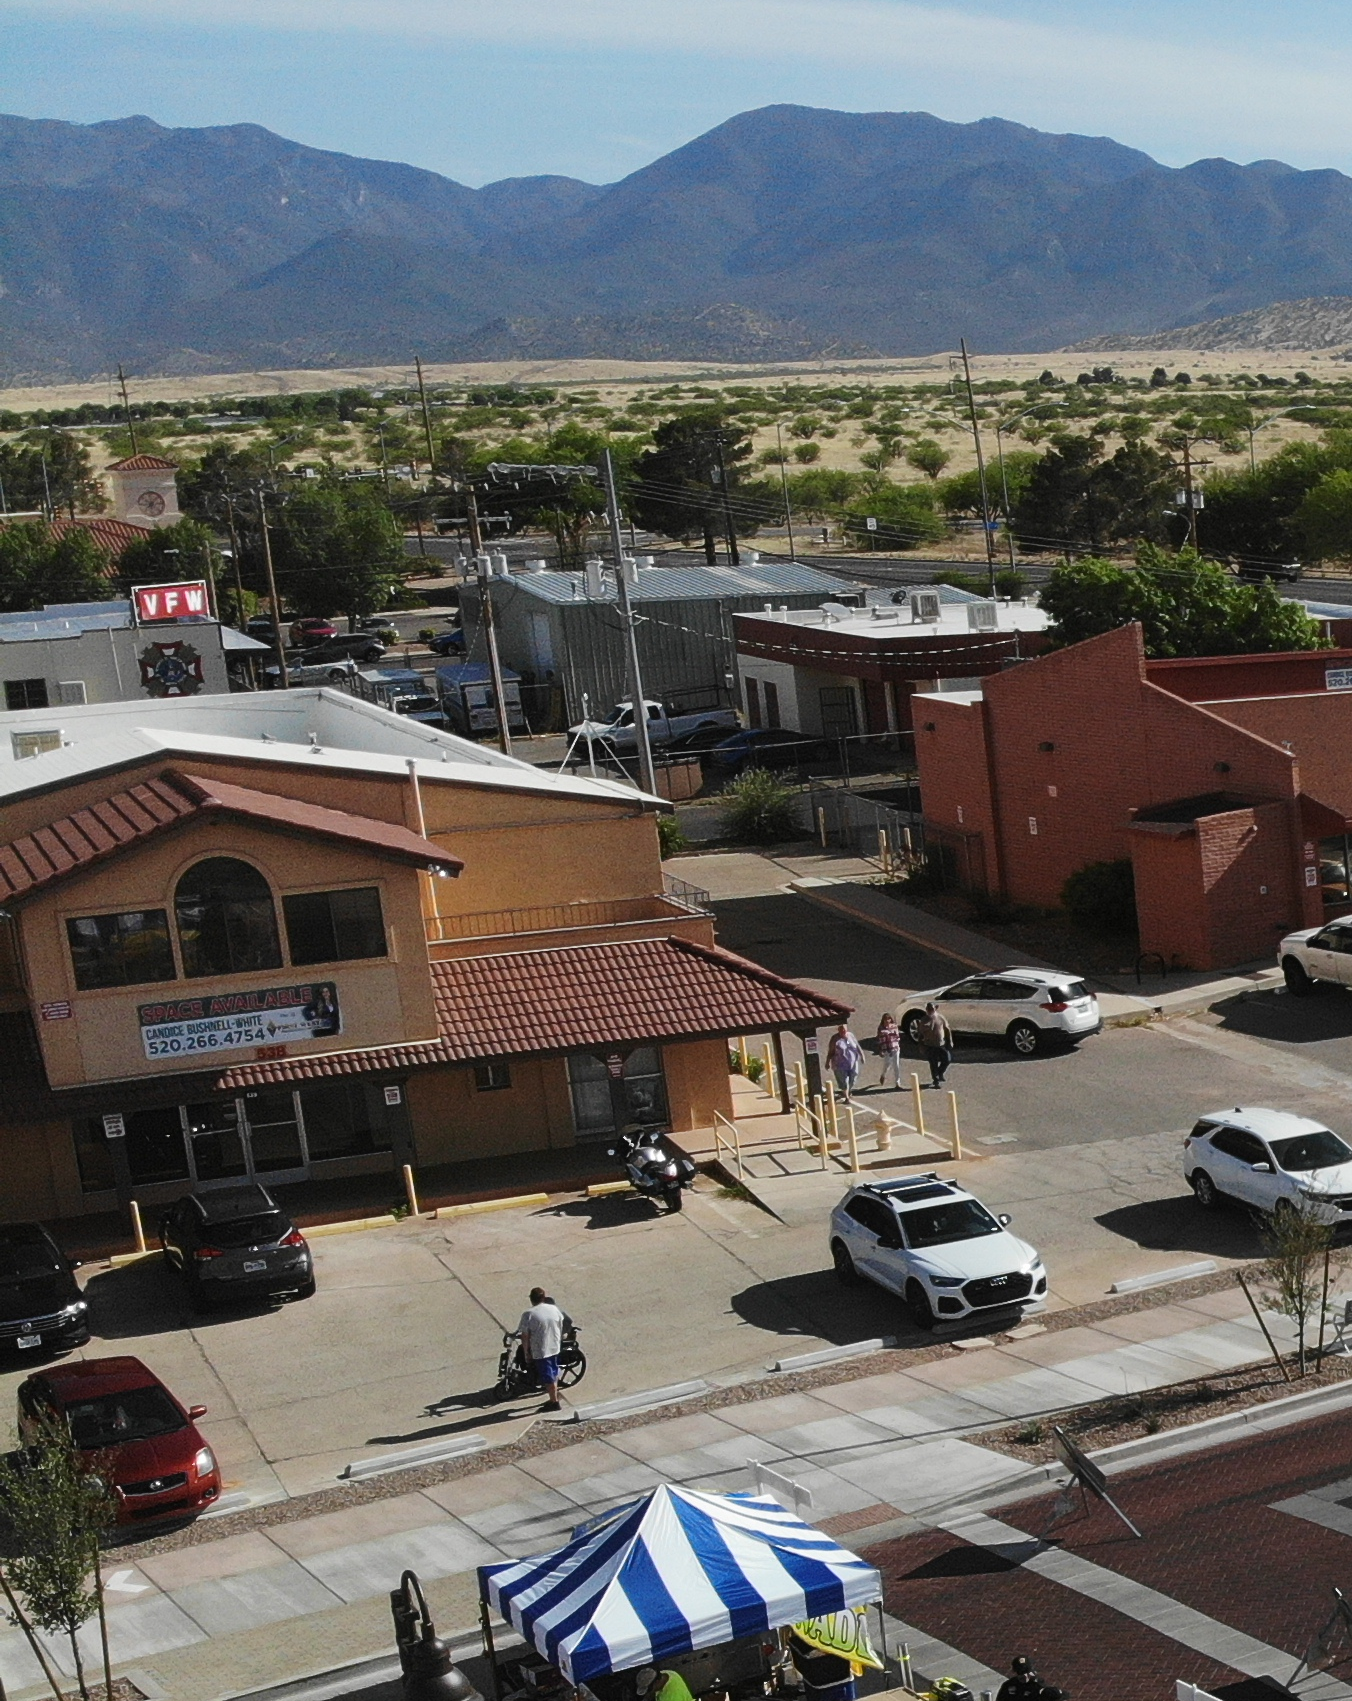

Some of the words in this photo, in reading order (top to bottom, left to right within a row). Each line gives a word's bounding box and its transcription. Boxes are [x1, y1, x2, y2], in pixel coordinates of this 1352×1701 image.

[143, 590, 201, 615] VFW
[142, 1000, 203, 1024] SPACE
[210, 987, 313, 1014] AVAILABLE
[145, 1026, 184, 1041] CANDICE
[149, 1028, 266, 1055] 520.266.4754
